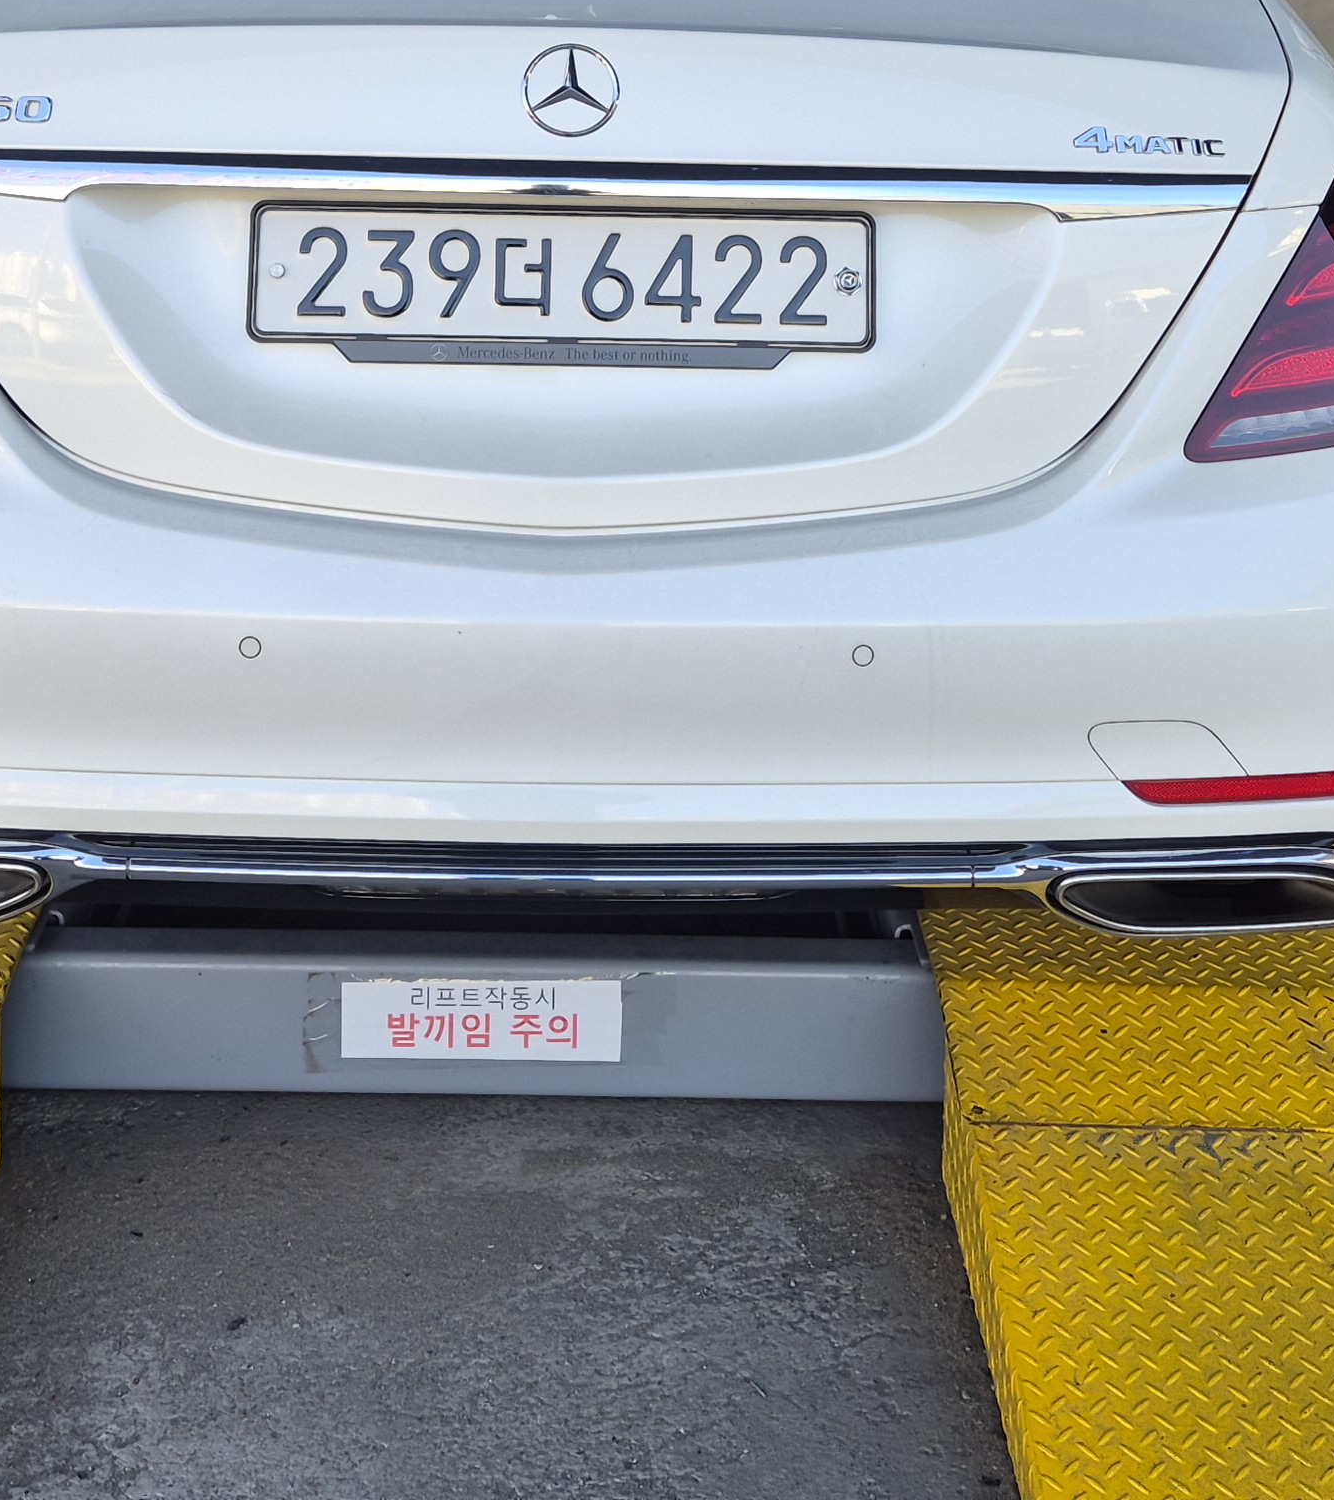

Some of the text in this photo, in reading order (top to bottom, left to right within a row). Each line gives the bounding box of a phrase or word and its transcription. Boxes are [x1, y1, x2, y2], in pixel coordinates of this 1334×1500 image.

[1073, 126, 1227, 158] 4MATIC
[296, 226, 828, 326] 239더 6422
[457, 346, 692, 365] Mercedes-Benz The best or nothing.
[410, 985, 557, 1012] 리프트작동시
[386, 1012, 579, 1049] 발끼임 주의
